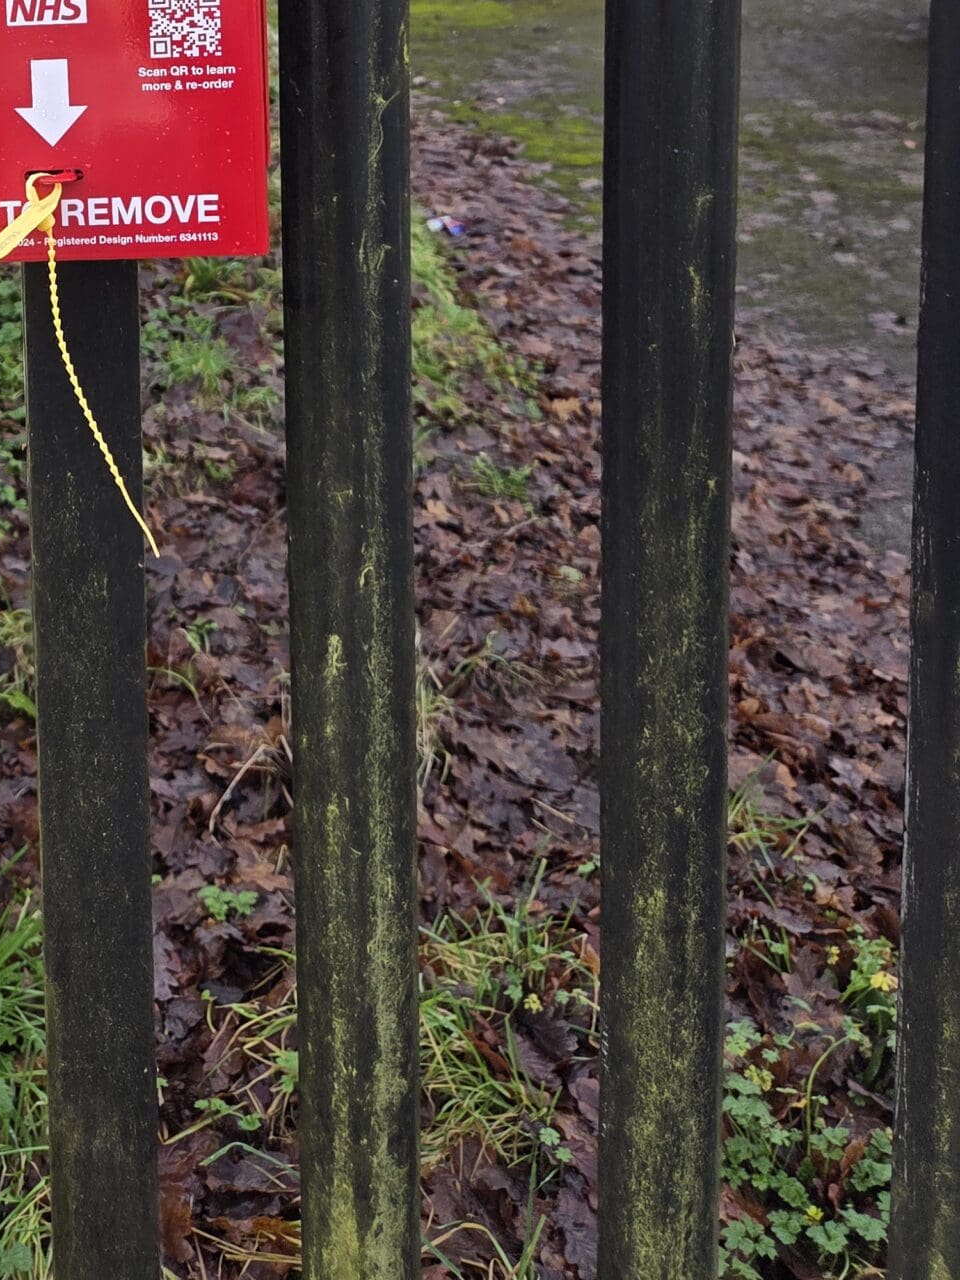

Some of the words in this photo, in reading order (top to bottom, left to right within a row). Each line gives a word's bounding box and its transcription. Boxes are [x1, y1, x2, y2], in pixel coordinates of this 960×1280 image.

[137, 66, 168, 78] Scan
[170, 65, 189, 76] QR
[190, 65, 204, 76] to
[206, 64, 236, 75] learn
[141, 82, 172, 92] more
[174, 79, 184, 91] &
[185, 78, 234, 90] re-order
[61, 194, 219, 226] REMOVE
[98, 235, 133, 246] Design
[135, 233, 177, 244] Number:
[179, 232, 219, 242] 6341113
